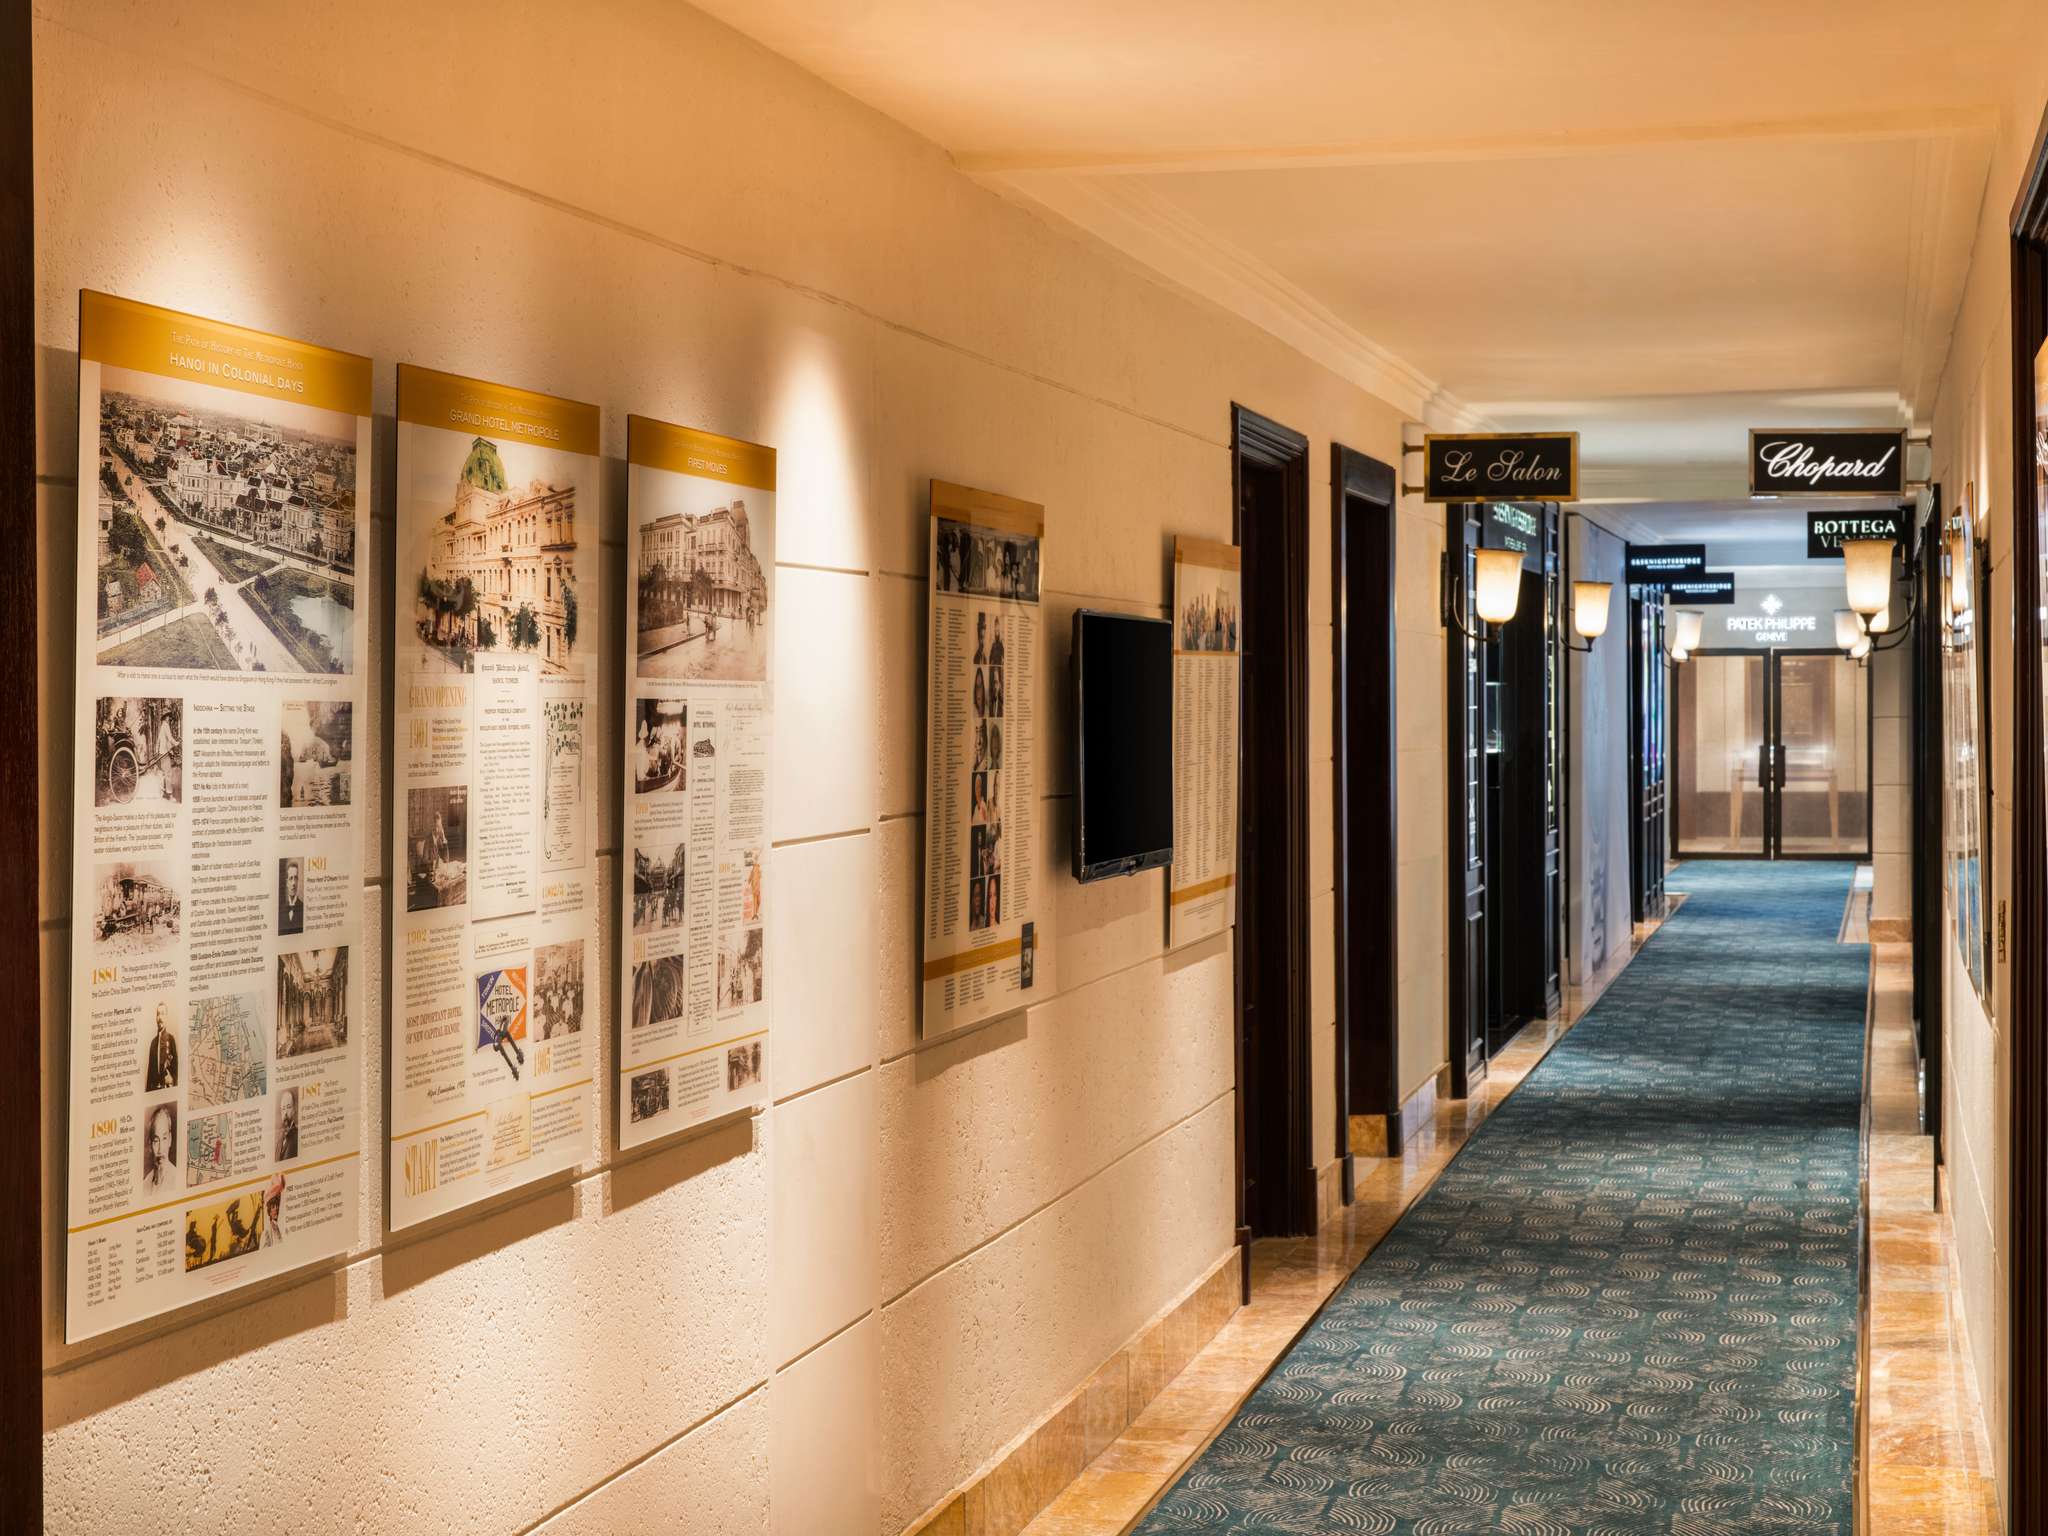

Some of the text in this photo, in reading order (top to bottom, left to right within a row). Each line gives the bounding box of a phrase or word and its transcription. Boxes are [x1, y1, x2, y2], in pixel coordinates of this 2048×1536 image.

[169, 352, 304, 394] HANOI IN COLONIAL DAYS
[449, 407, 560, 441] GRAND HOTEL METROPOLE
[687, 457, 728, 475] FIRST MOVES
[1441, 449, 1562, 482] Le Salon
[1760, 441, 1896, 485] Chopard
[1814, 520, 1896, 535] BOTTEGA
[1727, 617, 1817, 631] PATEK PHILIPPE
[93, 967, 118, 985] 1881
[495, 985, 513, 995] HOTEL
[486, 996, 520, 1017] METROPOLE
[90, 1119, 117, 1139] 1890
[404, 1139, 438, 1198] START
